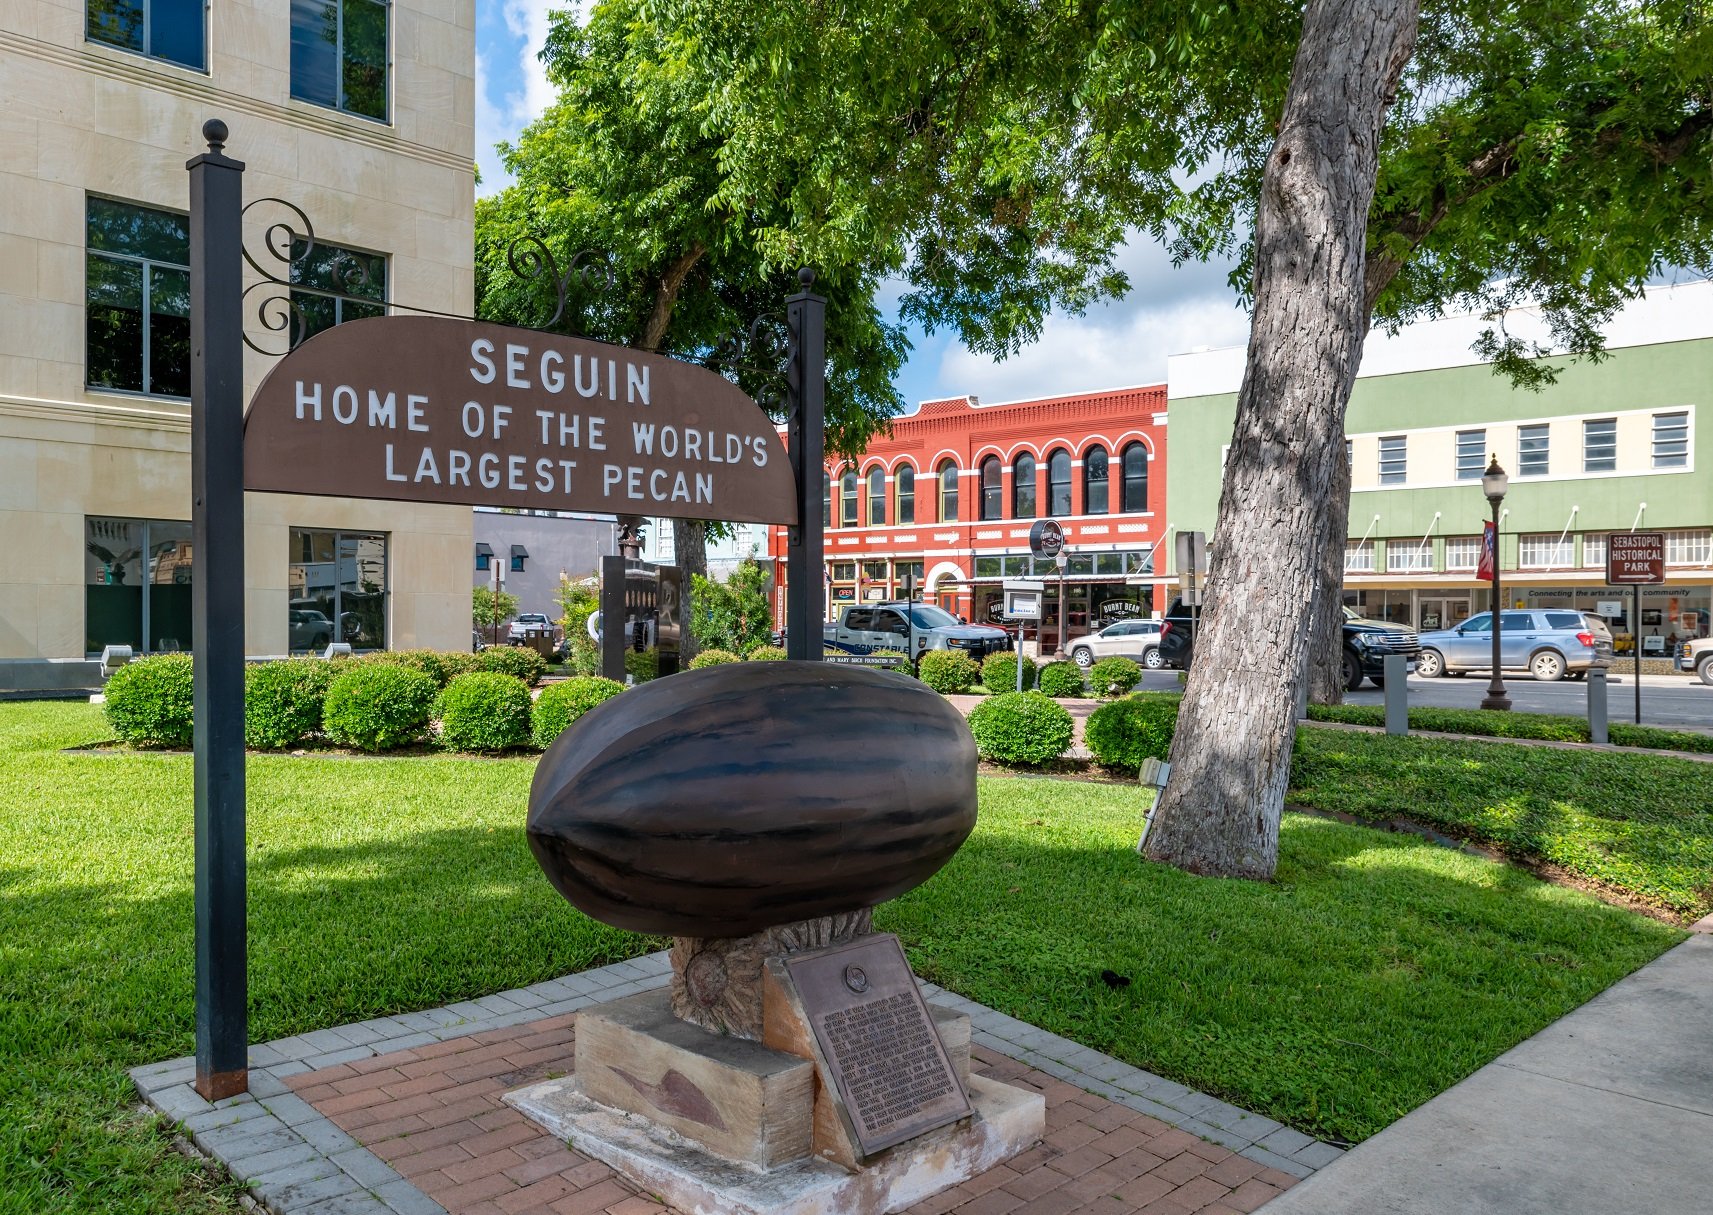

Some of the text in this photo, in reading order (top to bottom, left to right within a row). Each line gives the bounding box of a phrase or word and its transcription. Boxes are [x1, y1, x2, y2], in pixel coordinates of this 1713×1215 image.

[469, 338, 650, 406] SEGUIN
[295, 380, 768, 468] HOME OF THE WORLD'S
[385, 443, 713, 505] LARGEST PECAN
[1613, 536, 1661, 547] SEBASTOPOL
[1612, 550, 1662, 560] HISTORICAL
[1624, 562, 1650, 571] PARK
[838, 589, 853, 597] OPEN
[1103, 602, 1140, 614] BURNT BEAN
[854, 643, 909, 653] CONSTABLE
[864, 657, 888, 665] FOUNDATION
